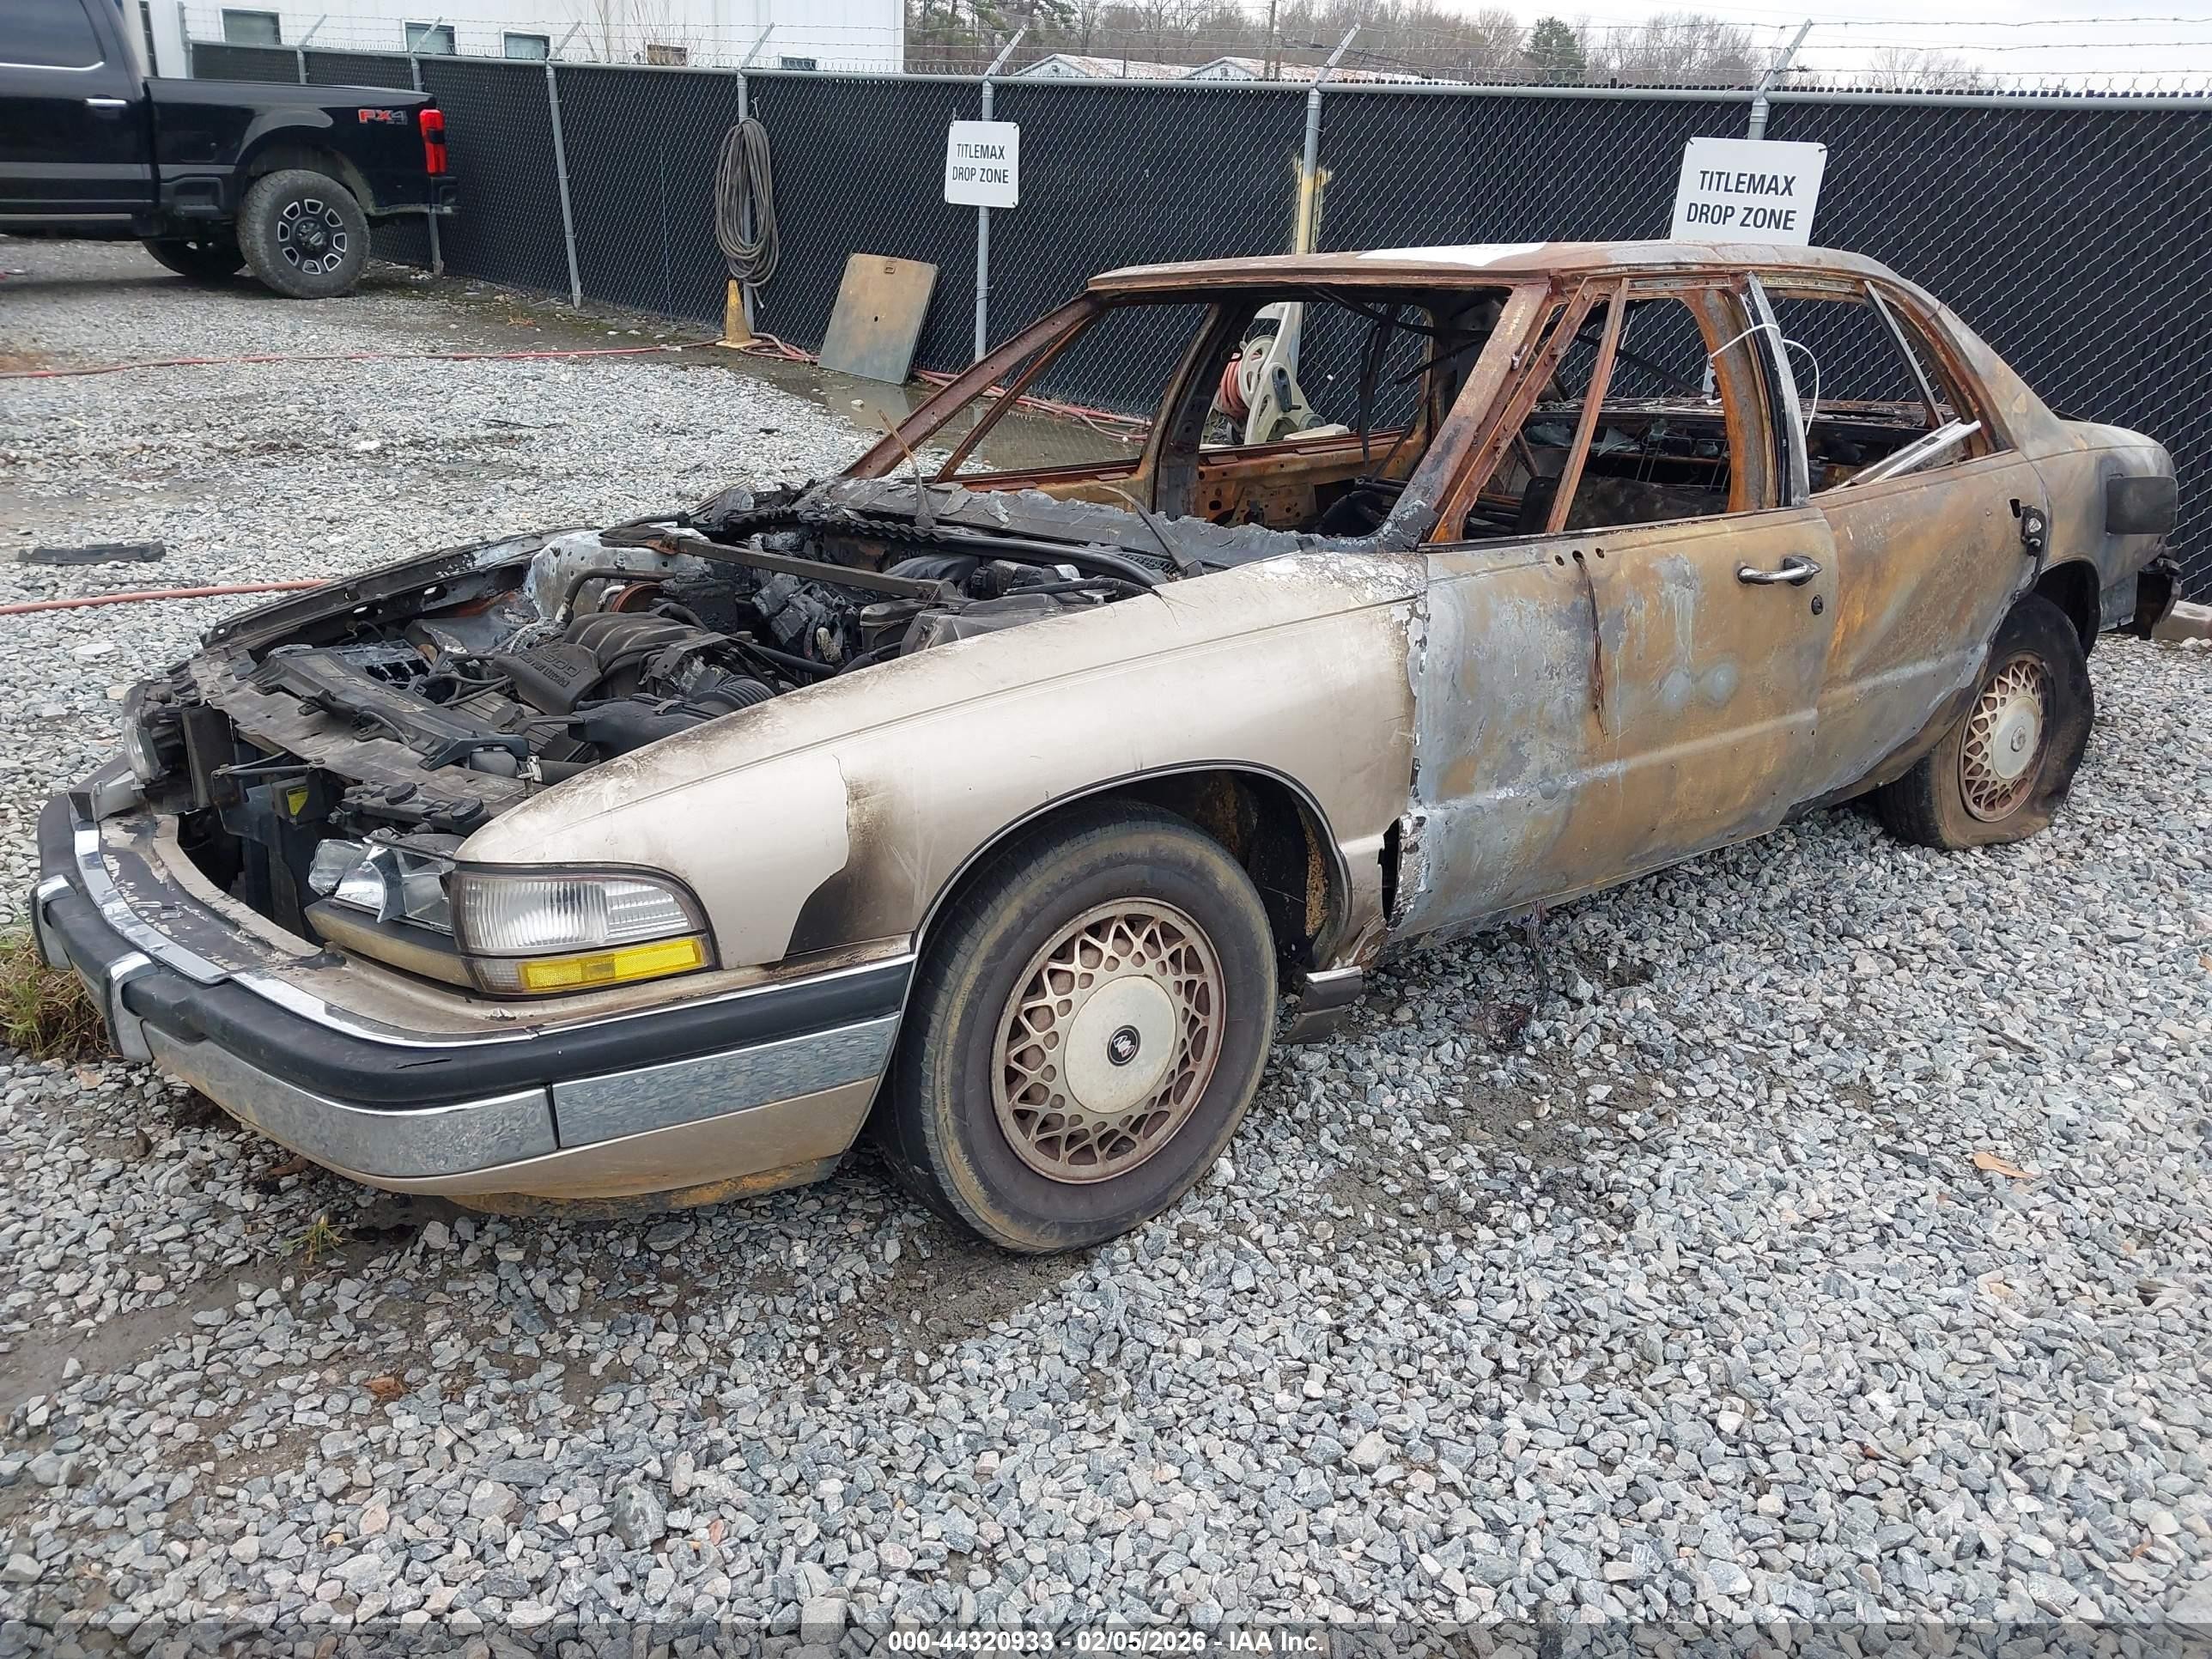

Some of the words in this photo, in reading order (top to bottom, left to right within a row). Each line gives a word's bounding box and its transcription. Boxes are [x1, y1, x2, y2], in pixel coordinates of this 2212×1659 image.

[357, 108, 406, 125] FX4
[957, 143, 1006, 160] TITLEMAX
[952, 166, 976, 182] DROP
[979, 167, 1009, 184] ZONE
[1699, 170, 1797, 197] TITLEMAX
[1686, 202, 1735, 225] DROP
[1739, 206, 1797, 231] ZONE
